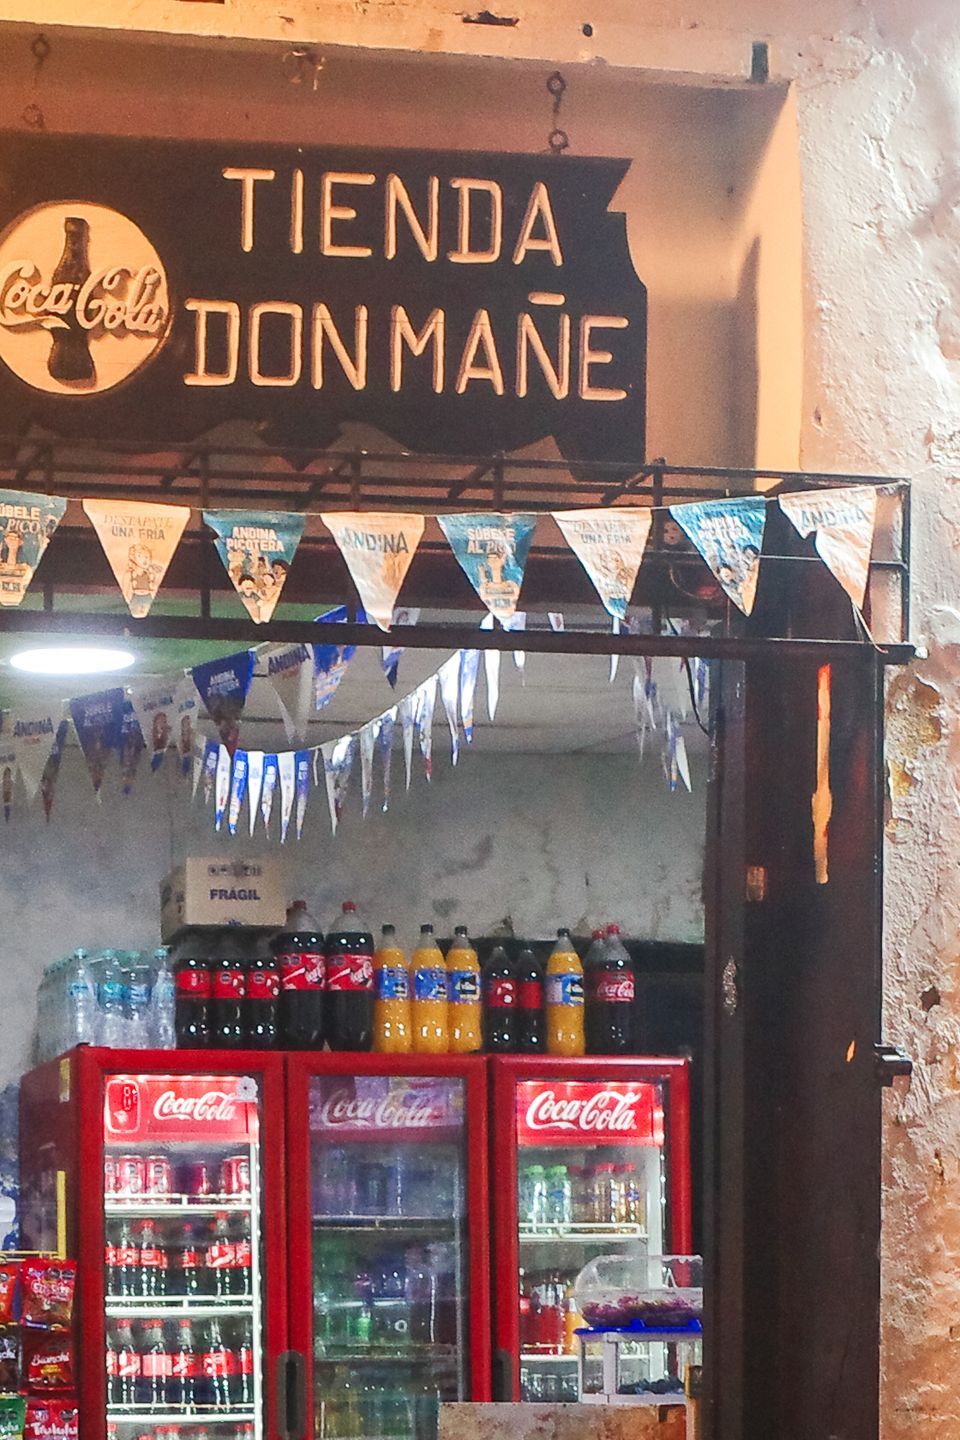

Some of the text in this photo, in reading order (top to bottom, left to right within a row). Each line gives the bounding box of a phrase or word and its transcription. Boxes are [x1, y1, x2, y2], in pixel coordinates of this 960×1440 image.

[223, 168, 563, 266] TIENDA
[184, 292, 629, 401] DON MAÑE
[7, 519, 40, 535] PICO
[111, 525, 134, 538] UNA
[232, 527, 278, 541] ANDINA
[226, 538, 284, 552] PICOTERA
[339, 527, 409, 553] ANDINA
[153, 1090, 238, 1121] Coca-Cola
[526, 1090, 642, 1130] Coca-Cola
[31, 1421, 77, 1435] Trululu
